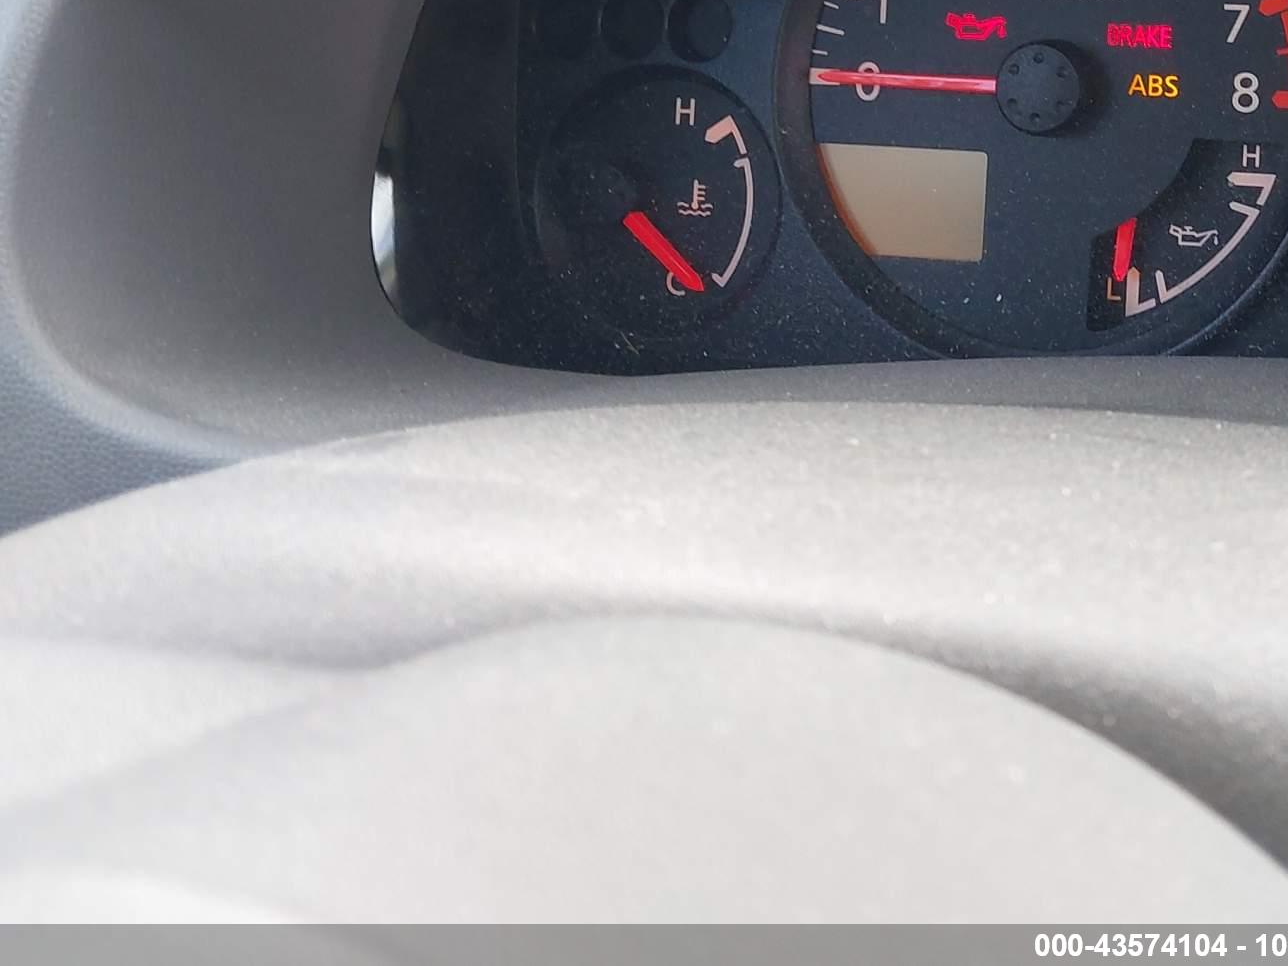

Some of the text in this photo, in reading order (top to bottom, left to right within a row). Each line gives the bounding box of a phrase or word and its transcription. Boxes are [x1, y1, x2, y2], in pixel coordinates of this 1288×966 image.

[1107, 23, 1172, 48] BRAKE
[1223, 3, 1251, 43] 7
[854, 62, 880, 101] 0
[1128, 75, 1179, 98] ABS
[1231, 72, 1259, 113] 8
[675, 97, 696, 126] H
[1242, 145, 1260, 167] H
[1106, 277, 1121, 301] L
